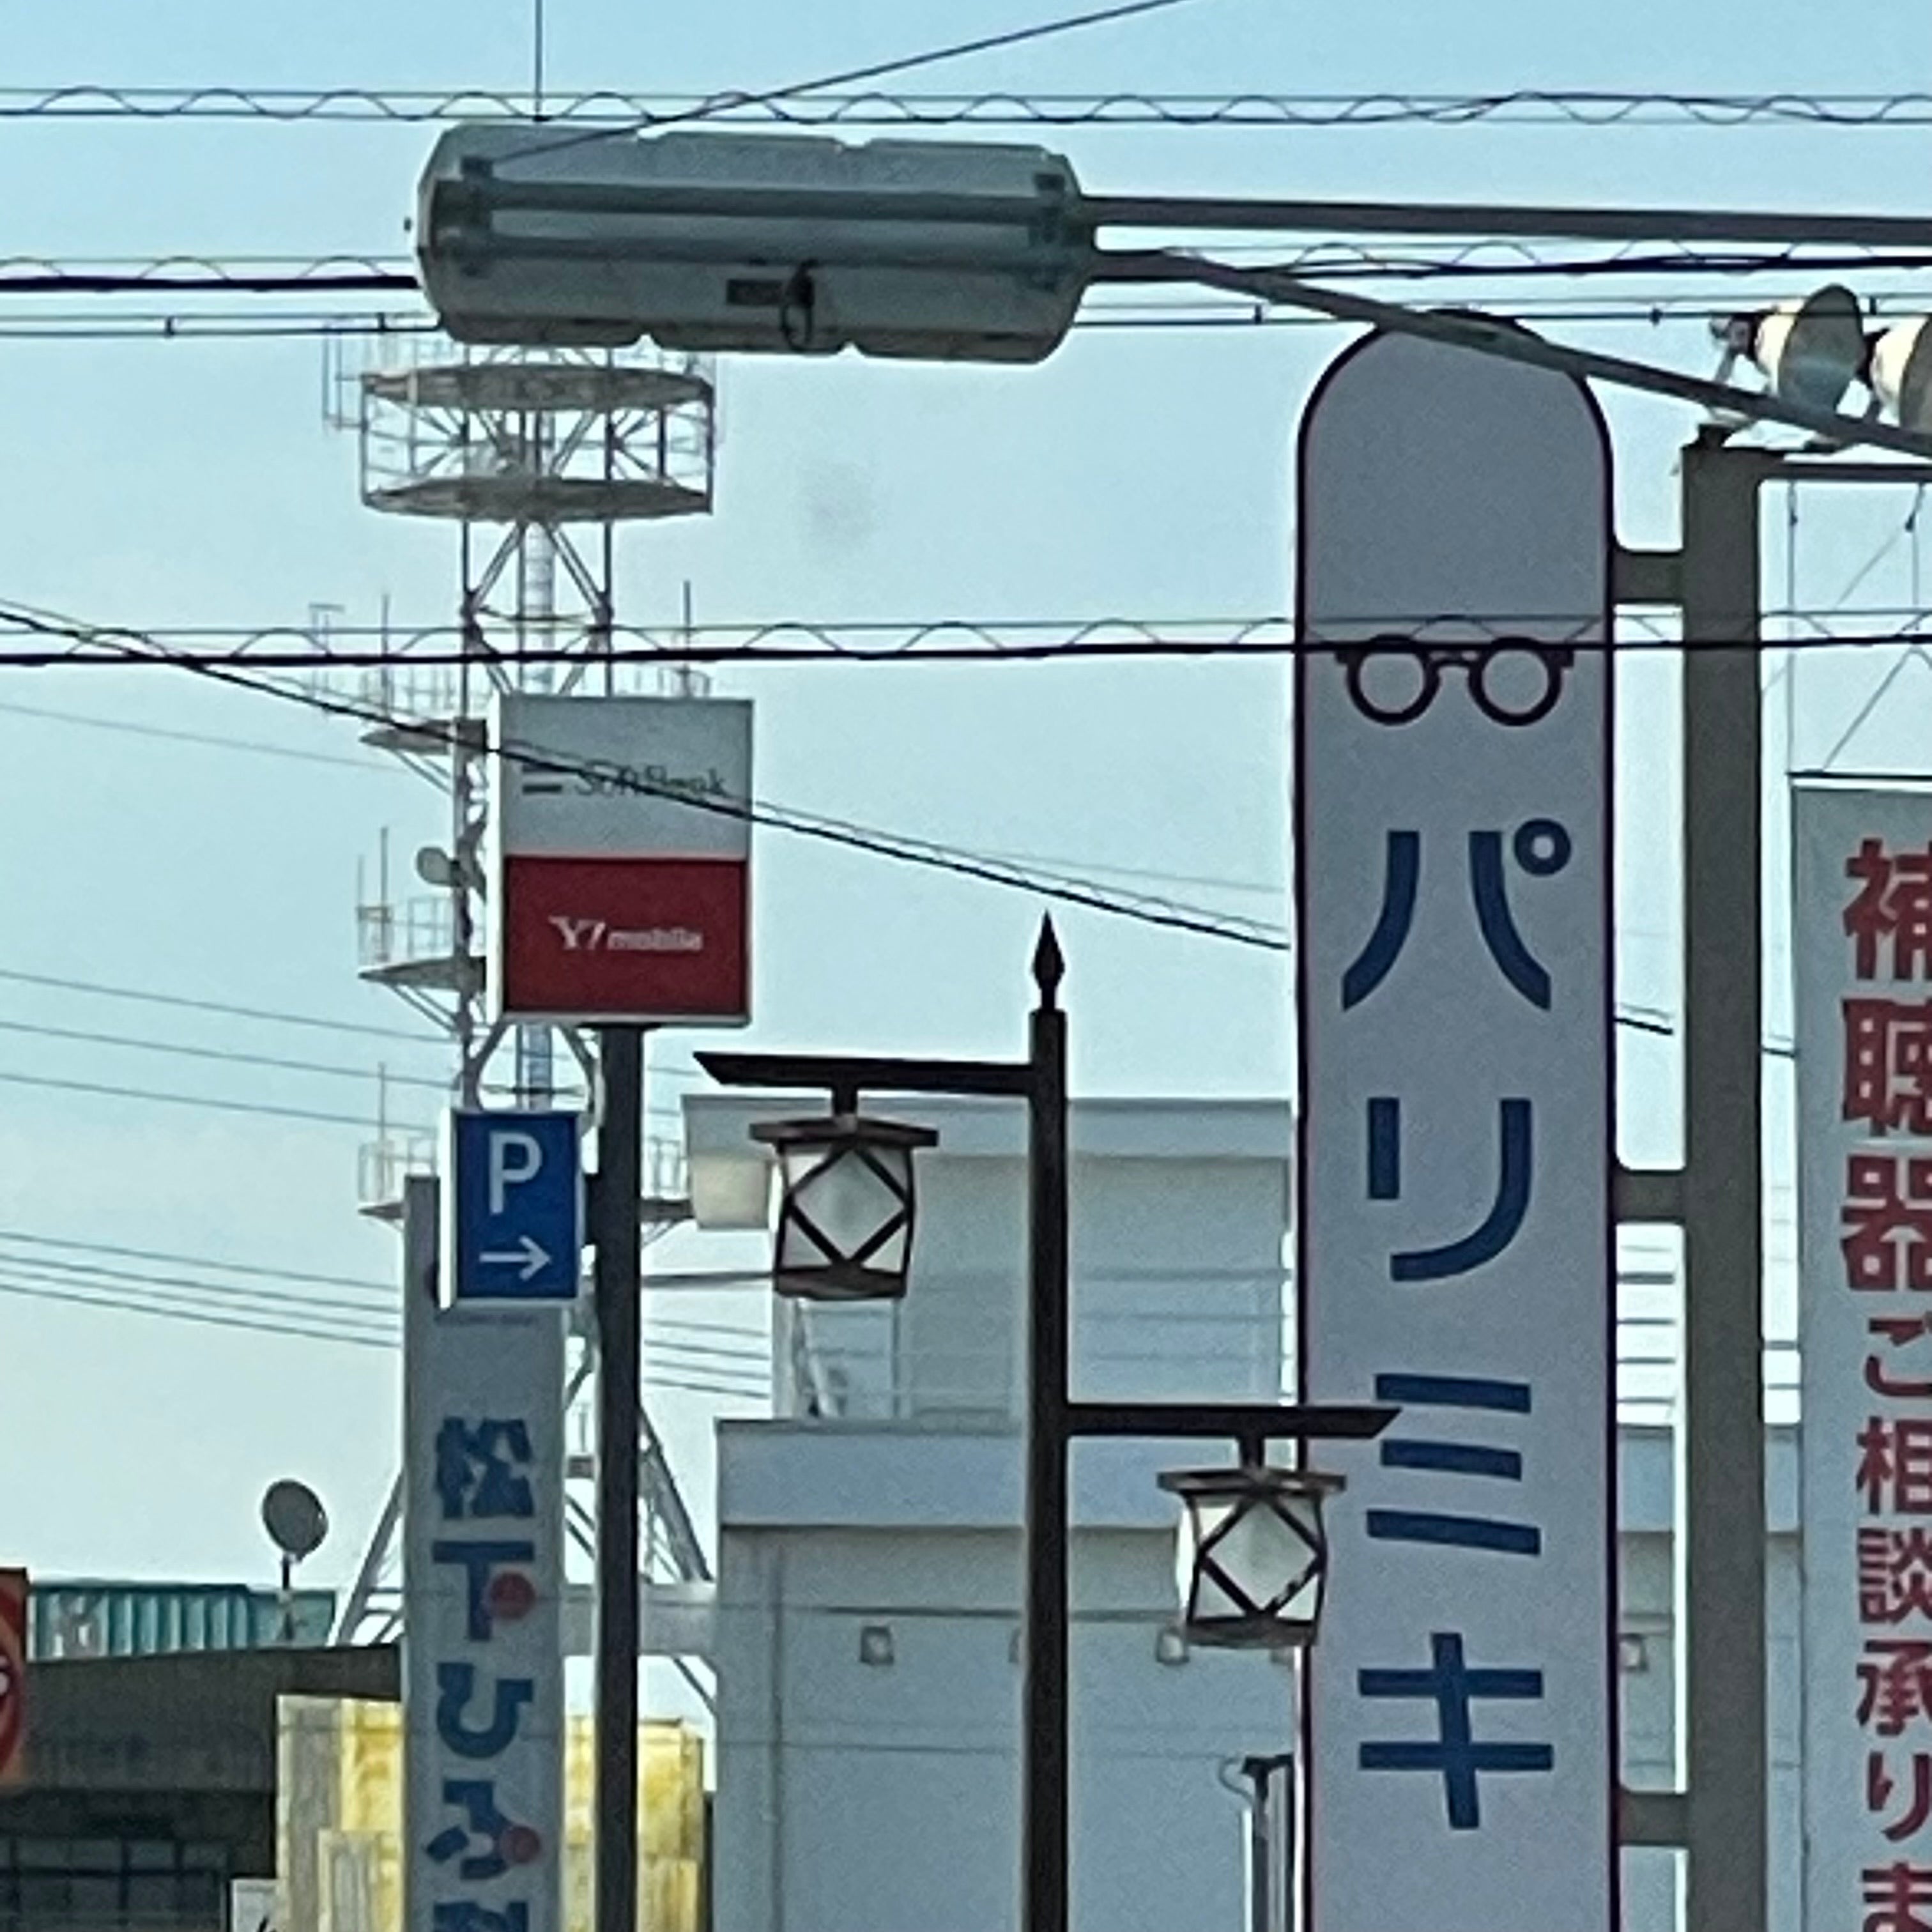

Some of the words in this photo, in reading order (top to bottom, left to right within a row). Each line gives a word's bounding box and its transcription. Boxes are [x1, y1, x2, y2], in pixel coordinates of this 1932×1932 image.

[489, 1131, 543, 1214] P
[1341, 817, 1572, 1829] パリミキ
